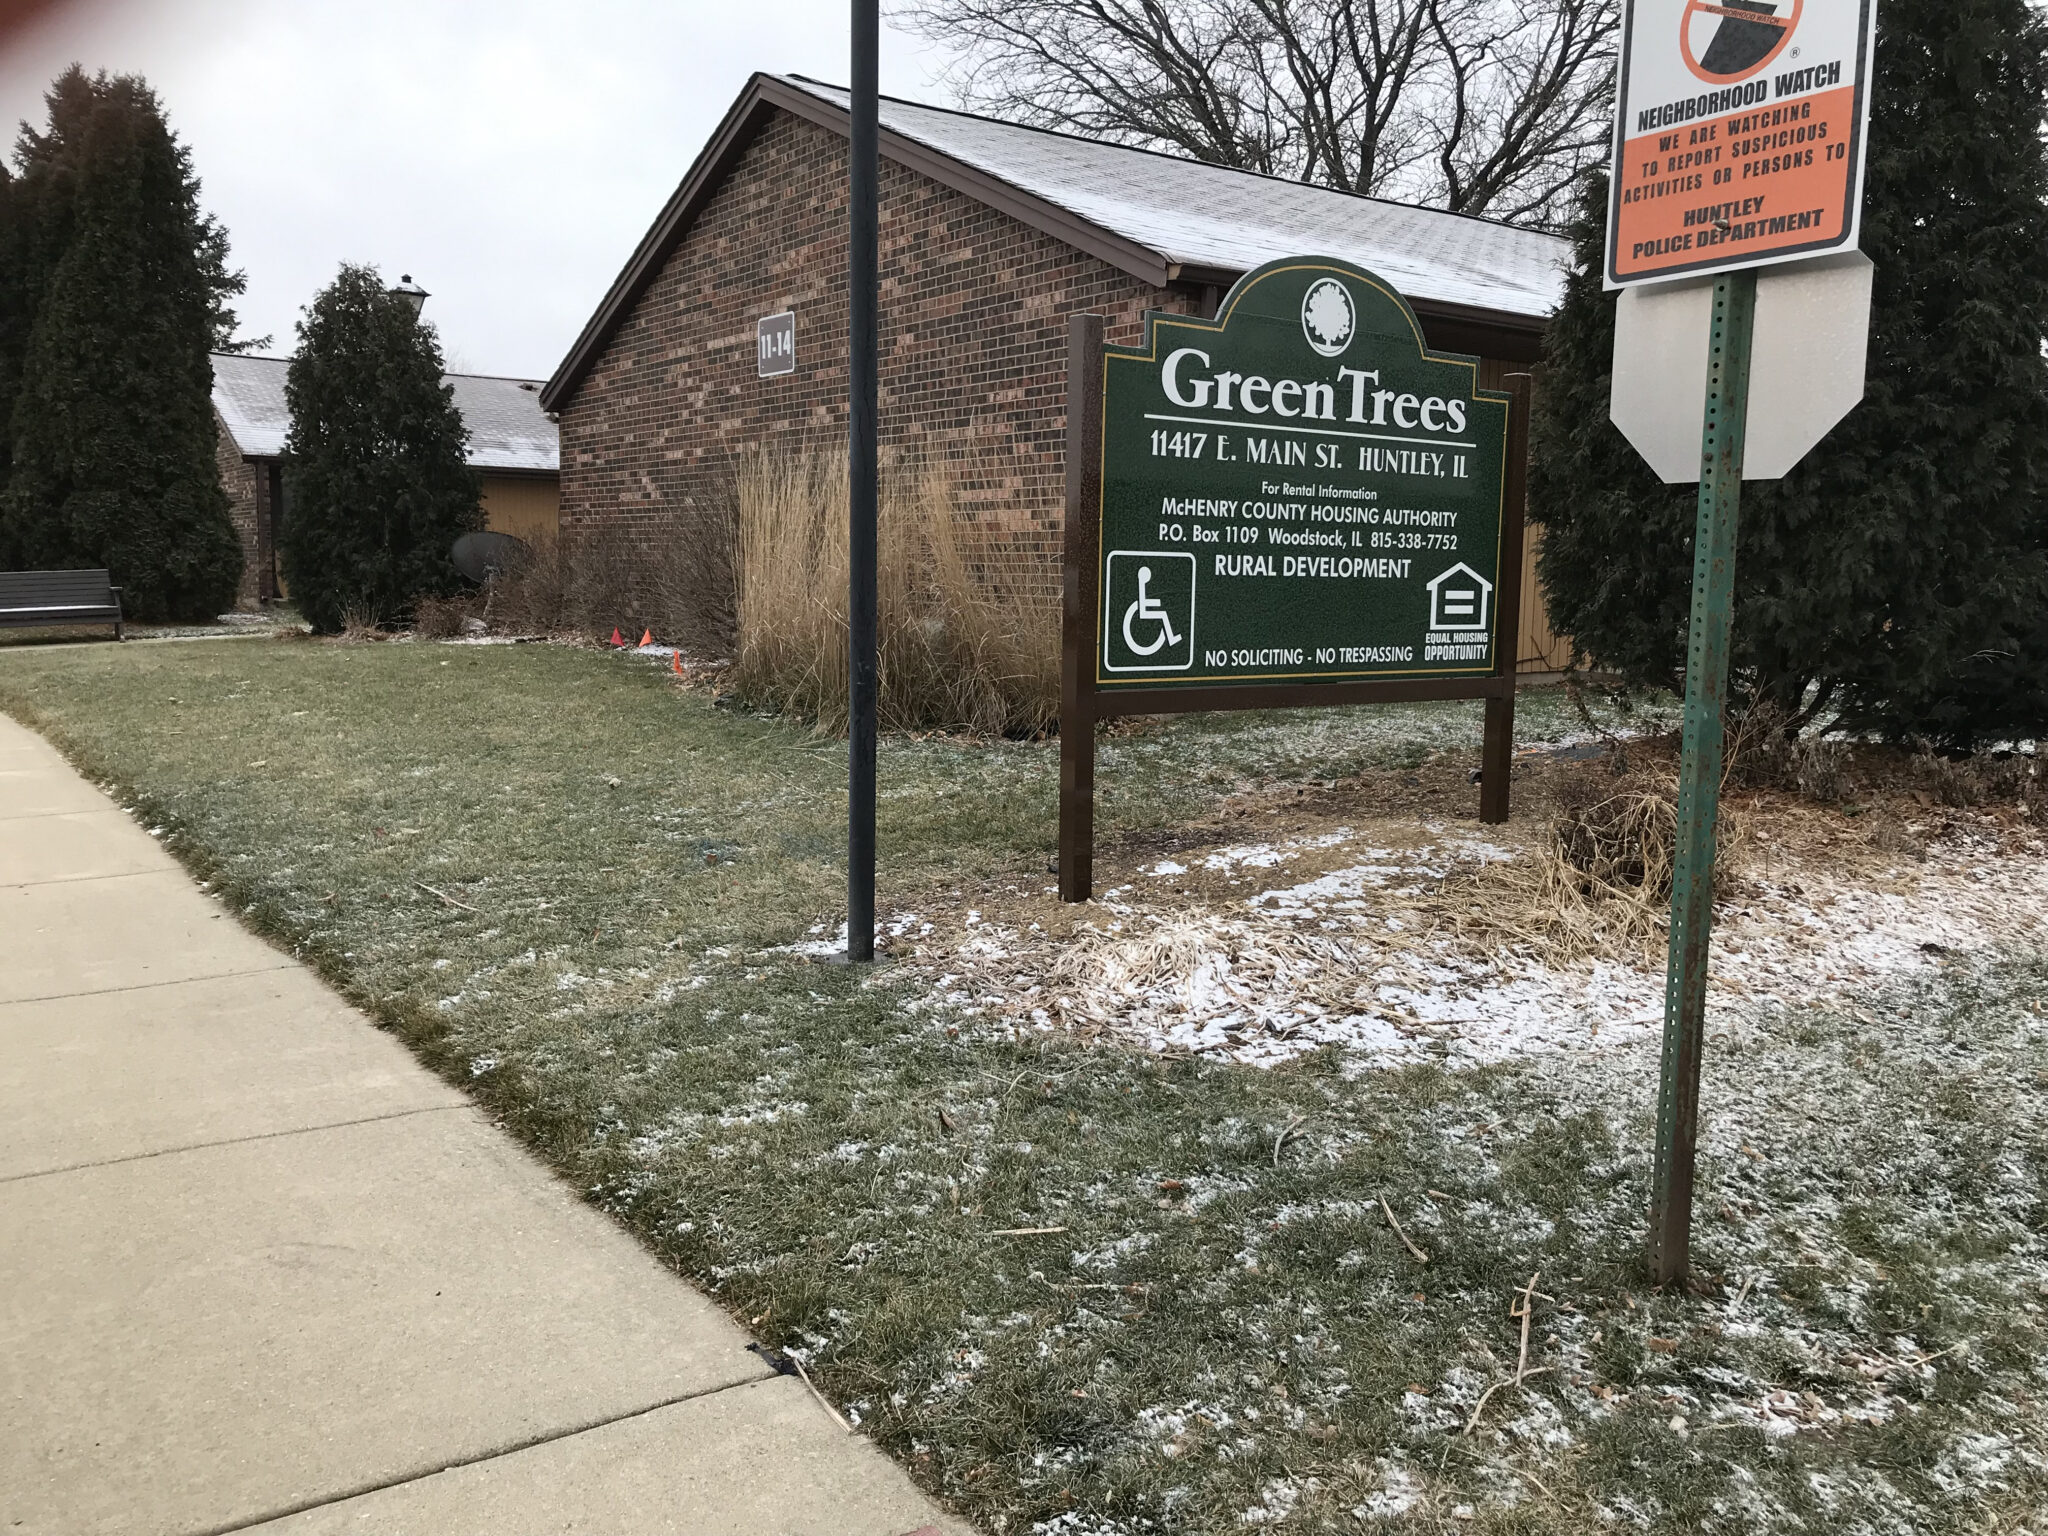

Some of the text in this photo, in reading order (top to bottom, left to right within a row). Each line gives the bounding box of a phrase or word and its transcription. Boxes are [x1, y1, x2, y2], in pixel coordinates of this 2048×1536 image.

[1756, 15, 1780, 25] WATCH
[1637, 60, 1841, 132] NEIGHBORHOOD WATCH
[1659, 102, 1811, 152] WE ARE WATCHING
[1642, 122, 1828, 178] TO REPORT SUSPICIOUS
[1624, 142, 1845, 204] ACTIVITIES OR PERSONS TO
[1683, 195, 1765, 227] HUNTLEY
[1632, 209, 1824, 259] POLICE DEPARTMENT
[761, 330, 791, 359] 11-14
[1161, 347, 1466, 434] Green Trees
[1150, 429, 1469, 479] 11417 E. MAIN ST. HUNTLEY, IL
[1261, 481, 1377, 500] For Rental Information
[1162, 497, 1457, 527] McHENRY COUNTY HOUSING AUTHORITY
[1159, 523, 1457, 550] P.O. Box 1109 Woodstock, IL 815-338-7752
[1215, 554, 1411, 578] RURAL DEVELOPMENT
[1424, 644, 1488, 661] OPPORTUNITY
[1425, 632, 1488, 644] EQUAL HOUSING
[1205, 650, 1227, 667] NO
[1231, 648, 1303, 666] SOLICITING
[1315, 647, 1336, 664] NO
[1339, 646, 1413, 663] TRESPASSING
